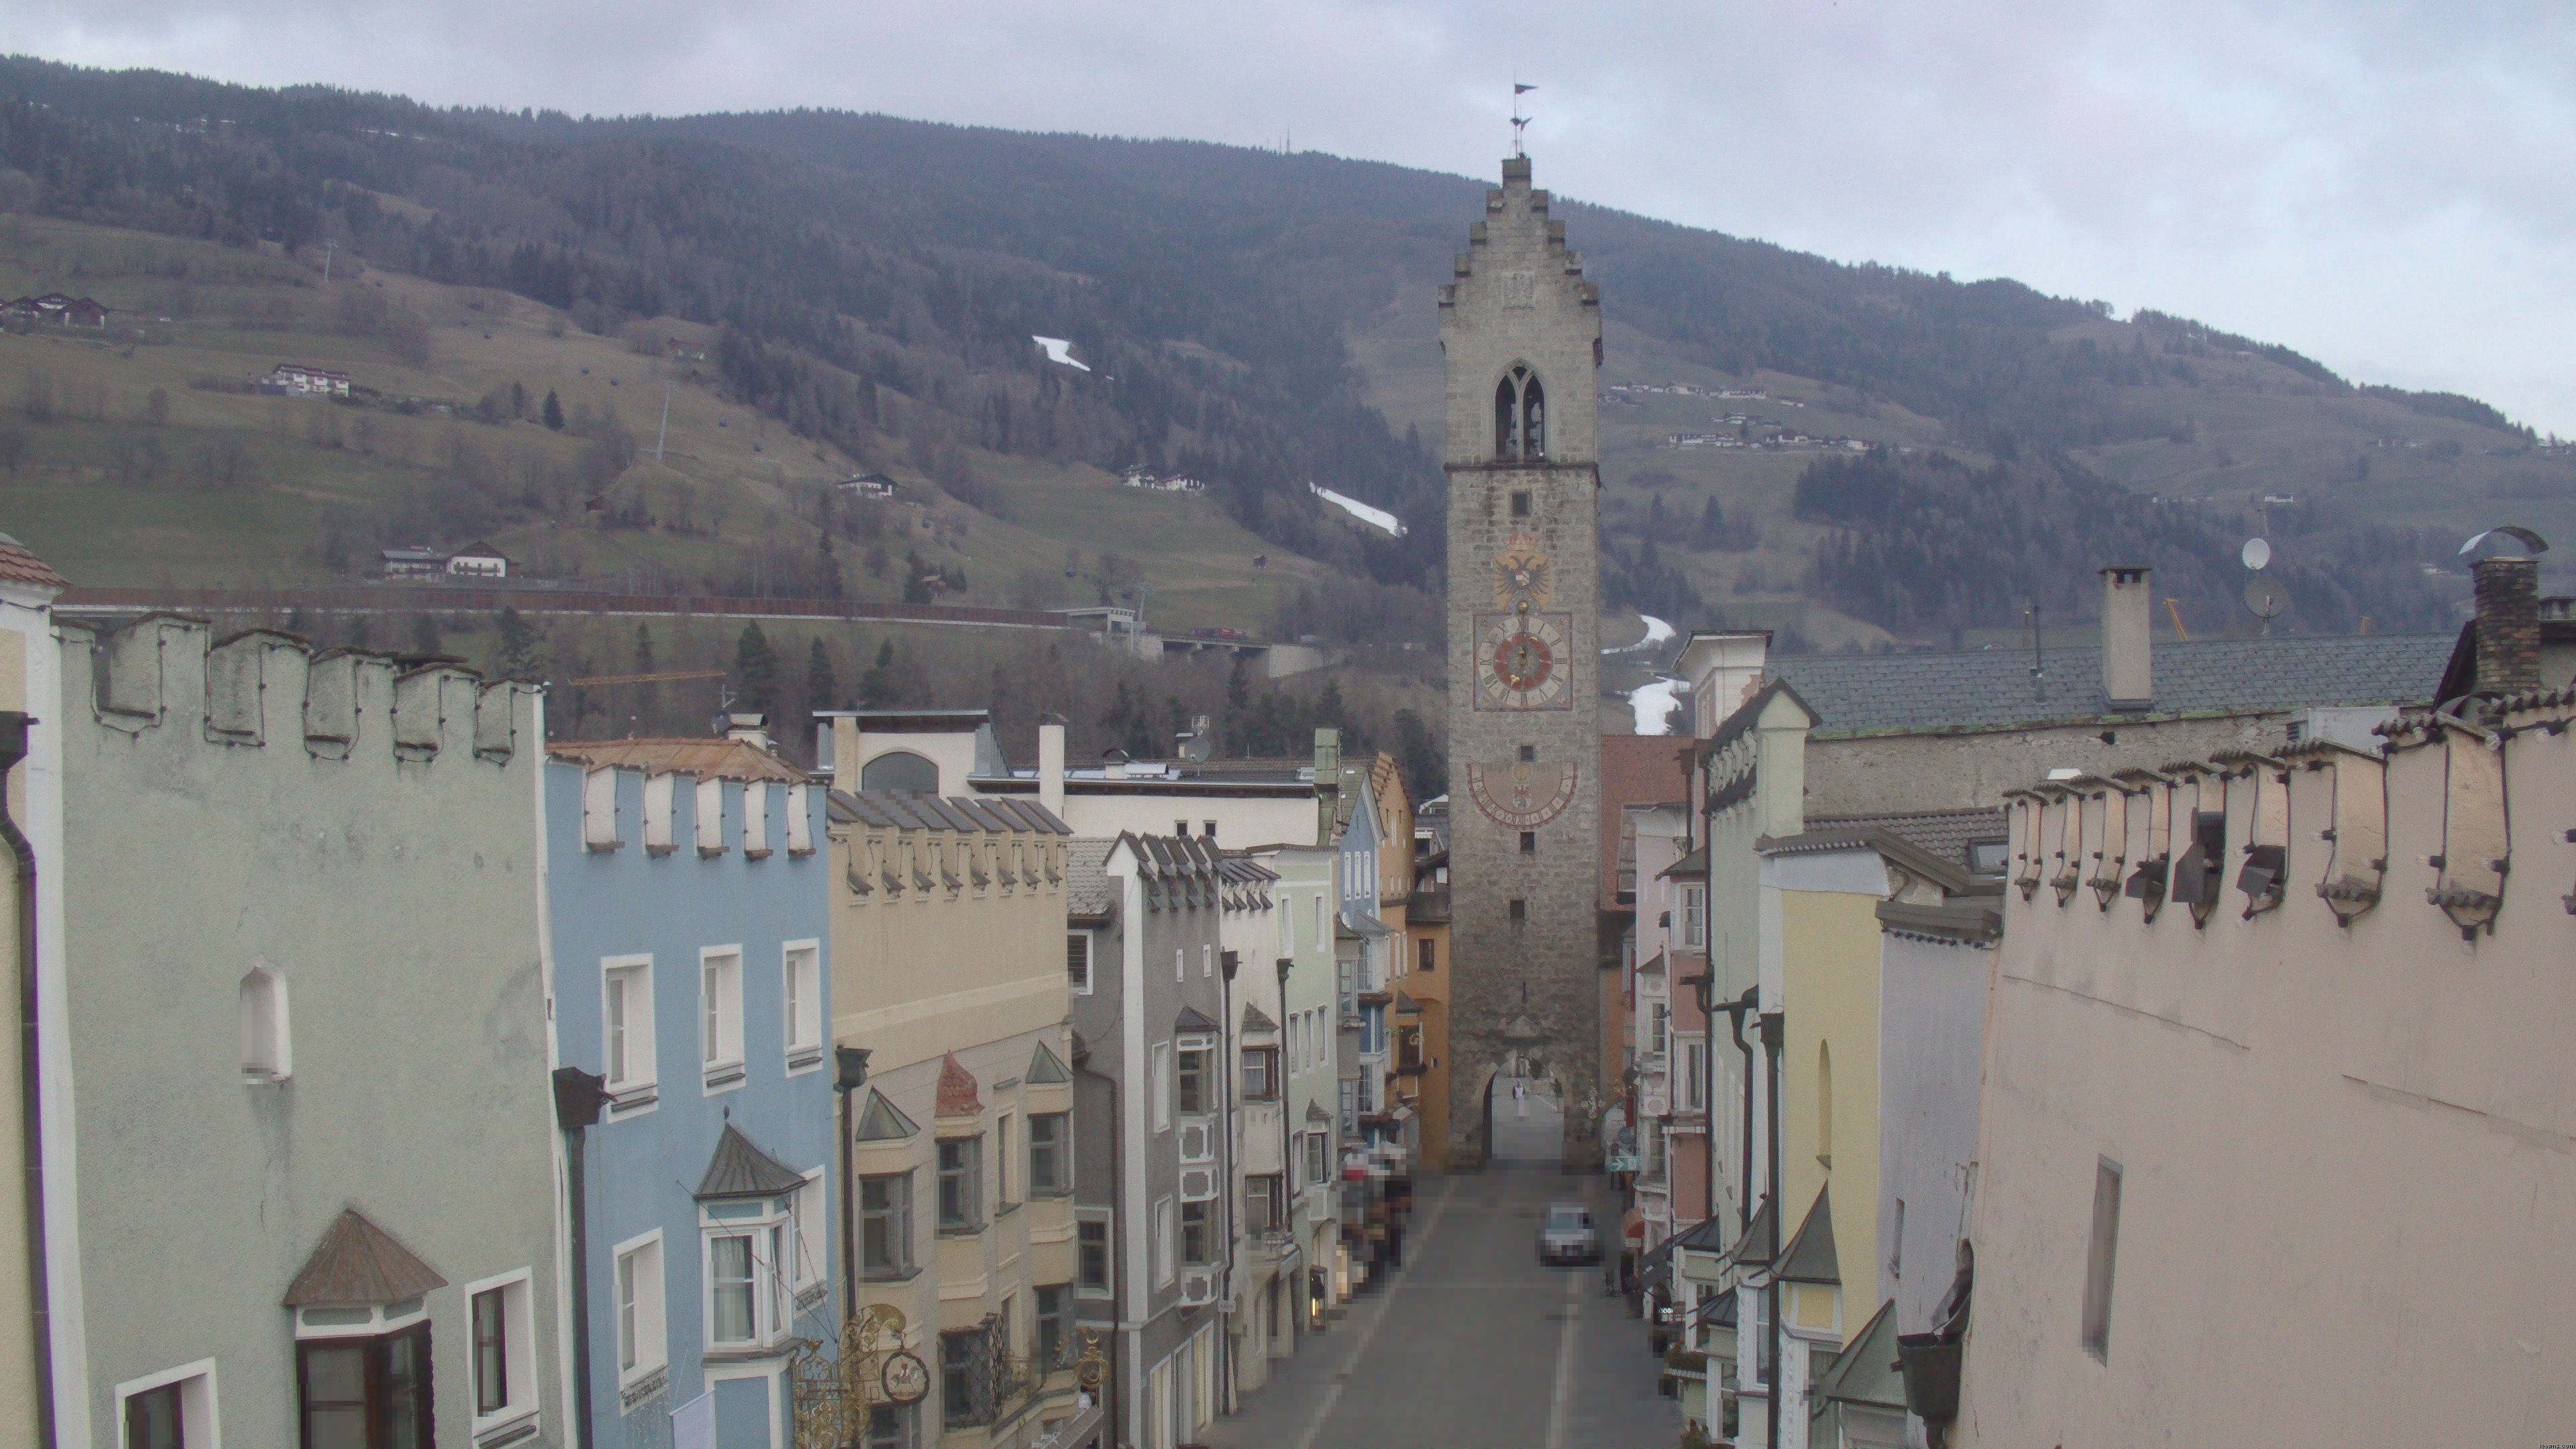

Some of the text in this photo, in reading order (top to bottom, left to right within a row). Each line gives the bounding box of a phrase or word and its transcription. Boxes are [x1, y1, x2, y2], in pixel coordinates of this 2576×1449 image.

[1538, 622, 1546, 635] I
[1549, 638, 1562, 647] II
[1538, 688, 1548, 701] V
